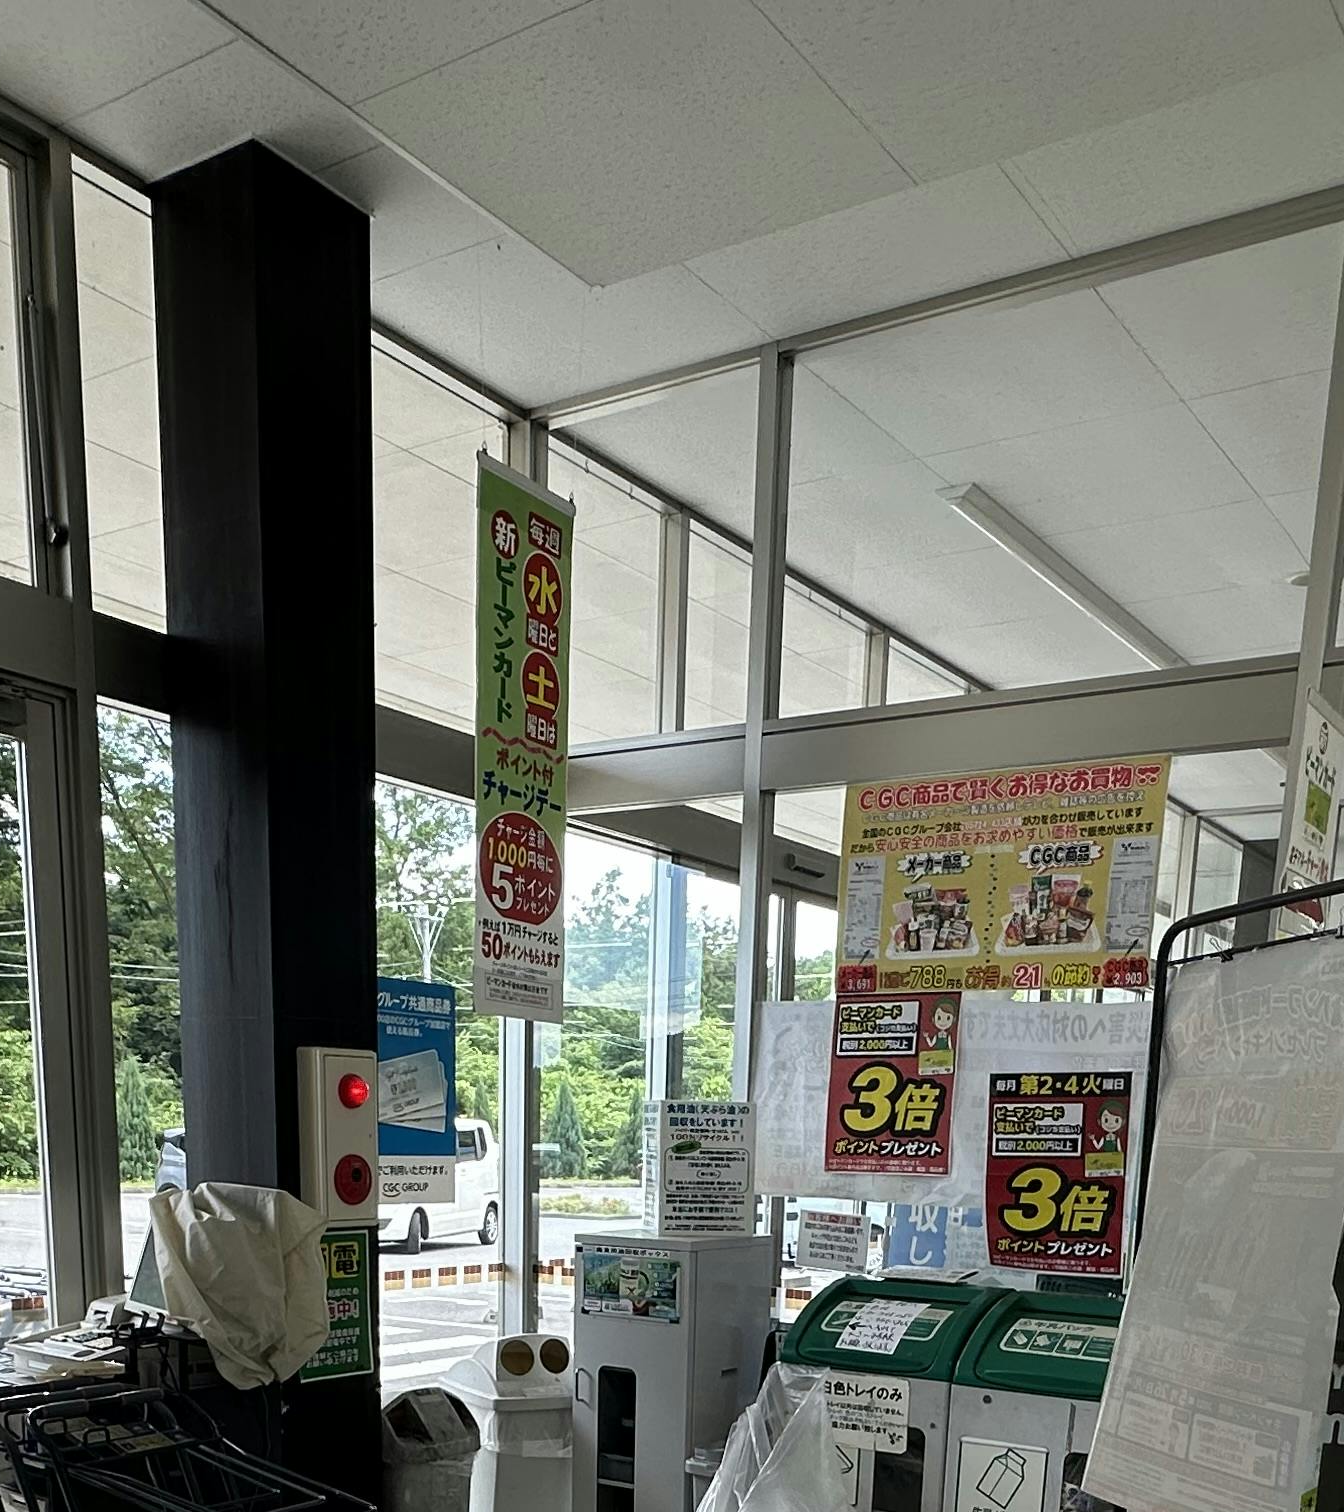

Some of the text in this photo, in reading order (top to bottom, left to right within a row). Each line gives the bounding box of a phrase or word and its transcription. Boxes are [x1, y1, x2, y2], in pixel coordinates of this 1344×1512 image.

[530, 517, 561, 556] 毎週
[528, 565, 558, 615] 水
[526, 665, 556, 712] 土
[496, 748, 554, 787] ポイント付
[483, 771, 561, 816] チャージデー
[1030, 845, 1090, 865] CGC商品
[491, 862, 556, 911] 5 ポイント
[1014, 964, 1042, 987] 21
[841, 1005, 902, 1019] ピーマンカード
[844, 1065, 941, 1132] 3倍
[995, 1106, 1064, 1120] ピーマンカード
[1003, 1167, 1109, 1232] 3倍
